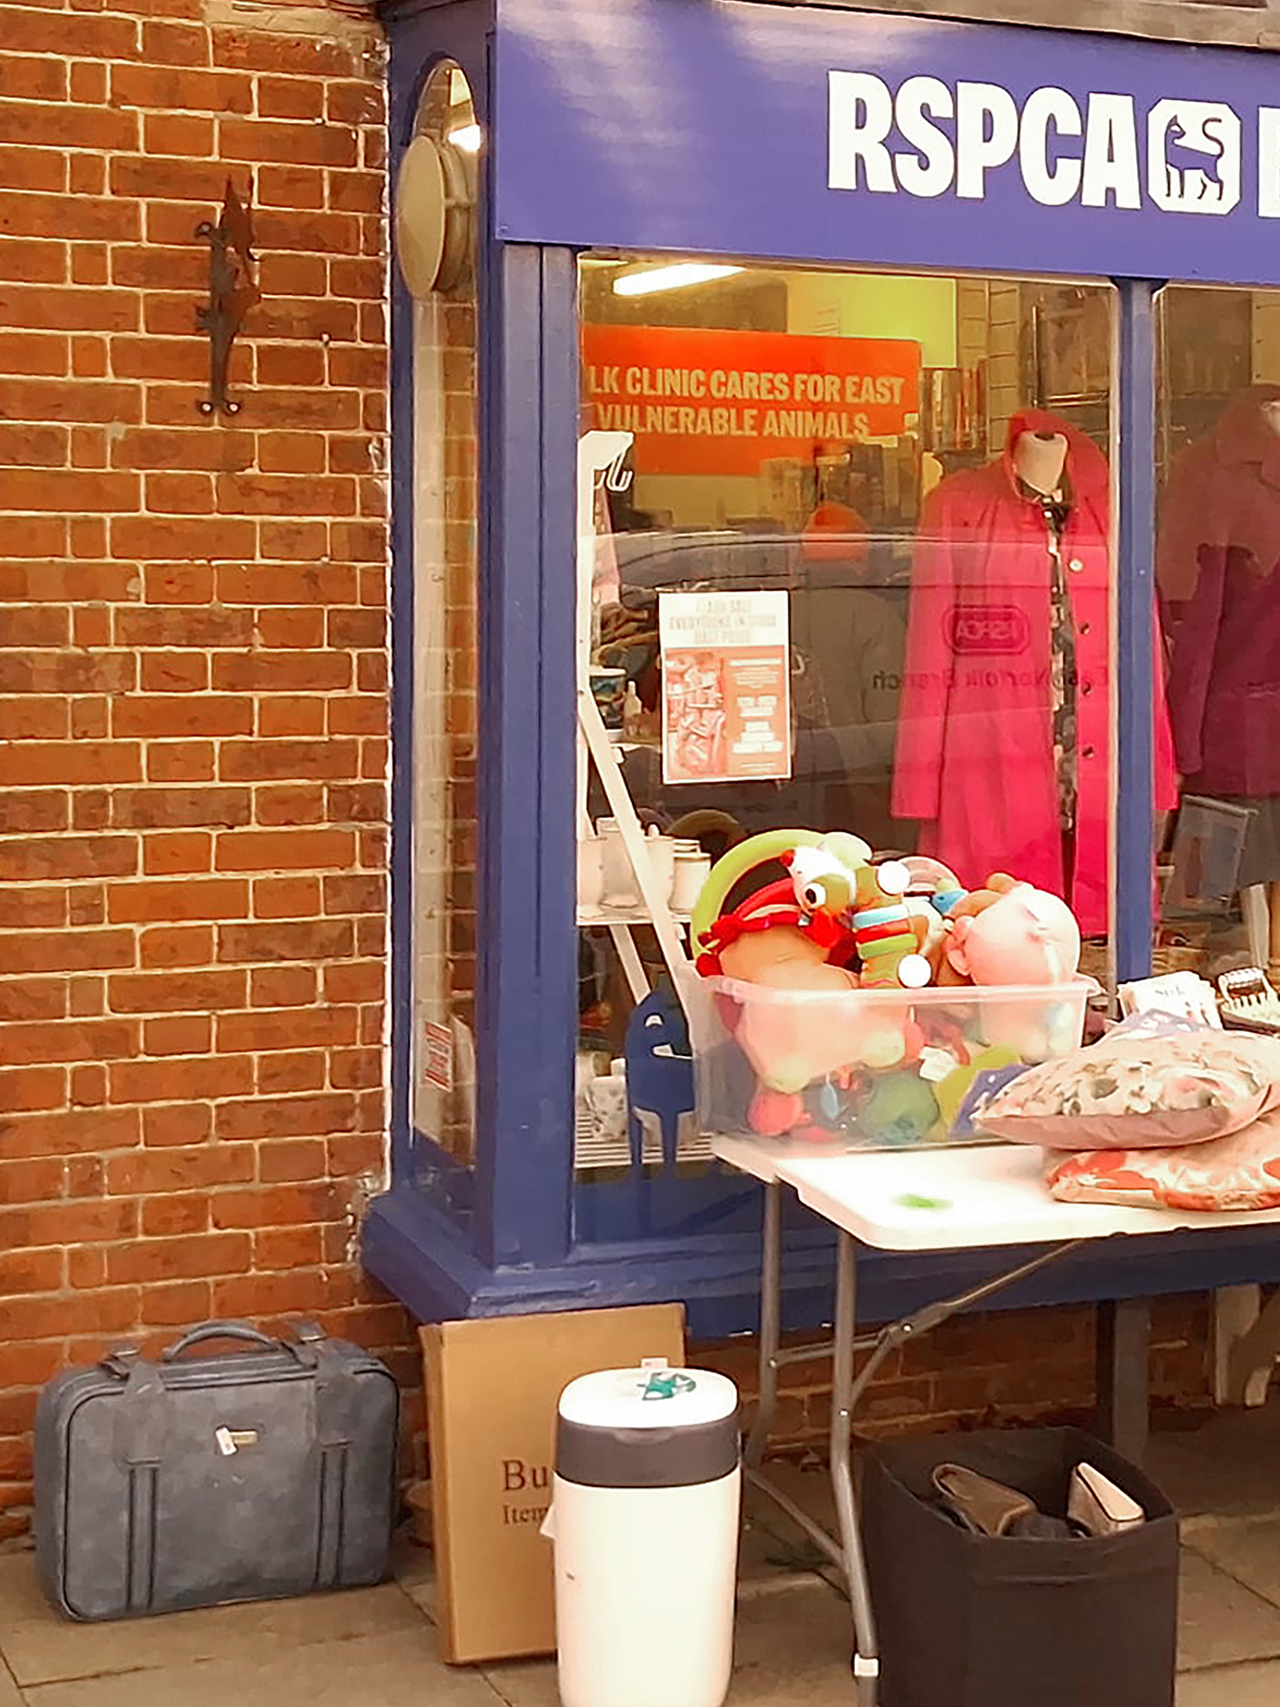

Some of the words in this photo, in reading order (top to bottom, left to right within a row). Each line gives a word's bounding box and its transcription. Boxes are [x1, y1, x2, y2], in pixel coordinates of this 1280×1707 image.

[828, 70, 1141, 209] RSPCA
[626, 367, 706, 397] CLINIC
[710, 370, 790, 400] CARES
[794, 373, 841, 402] FOR
[845, 376, 905, 404] EAST
[598, 403, 758, 436] VULNERABLE
[763, 410, 870, 441] ANIMALS
